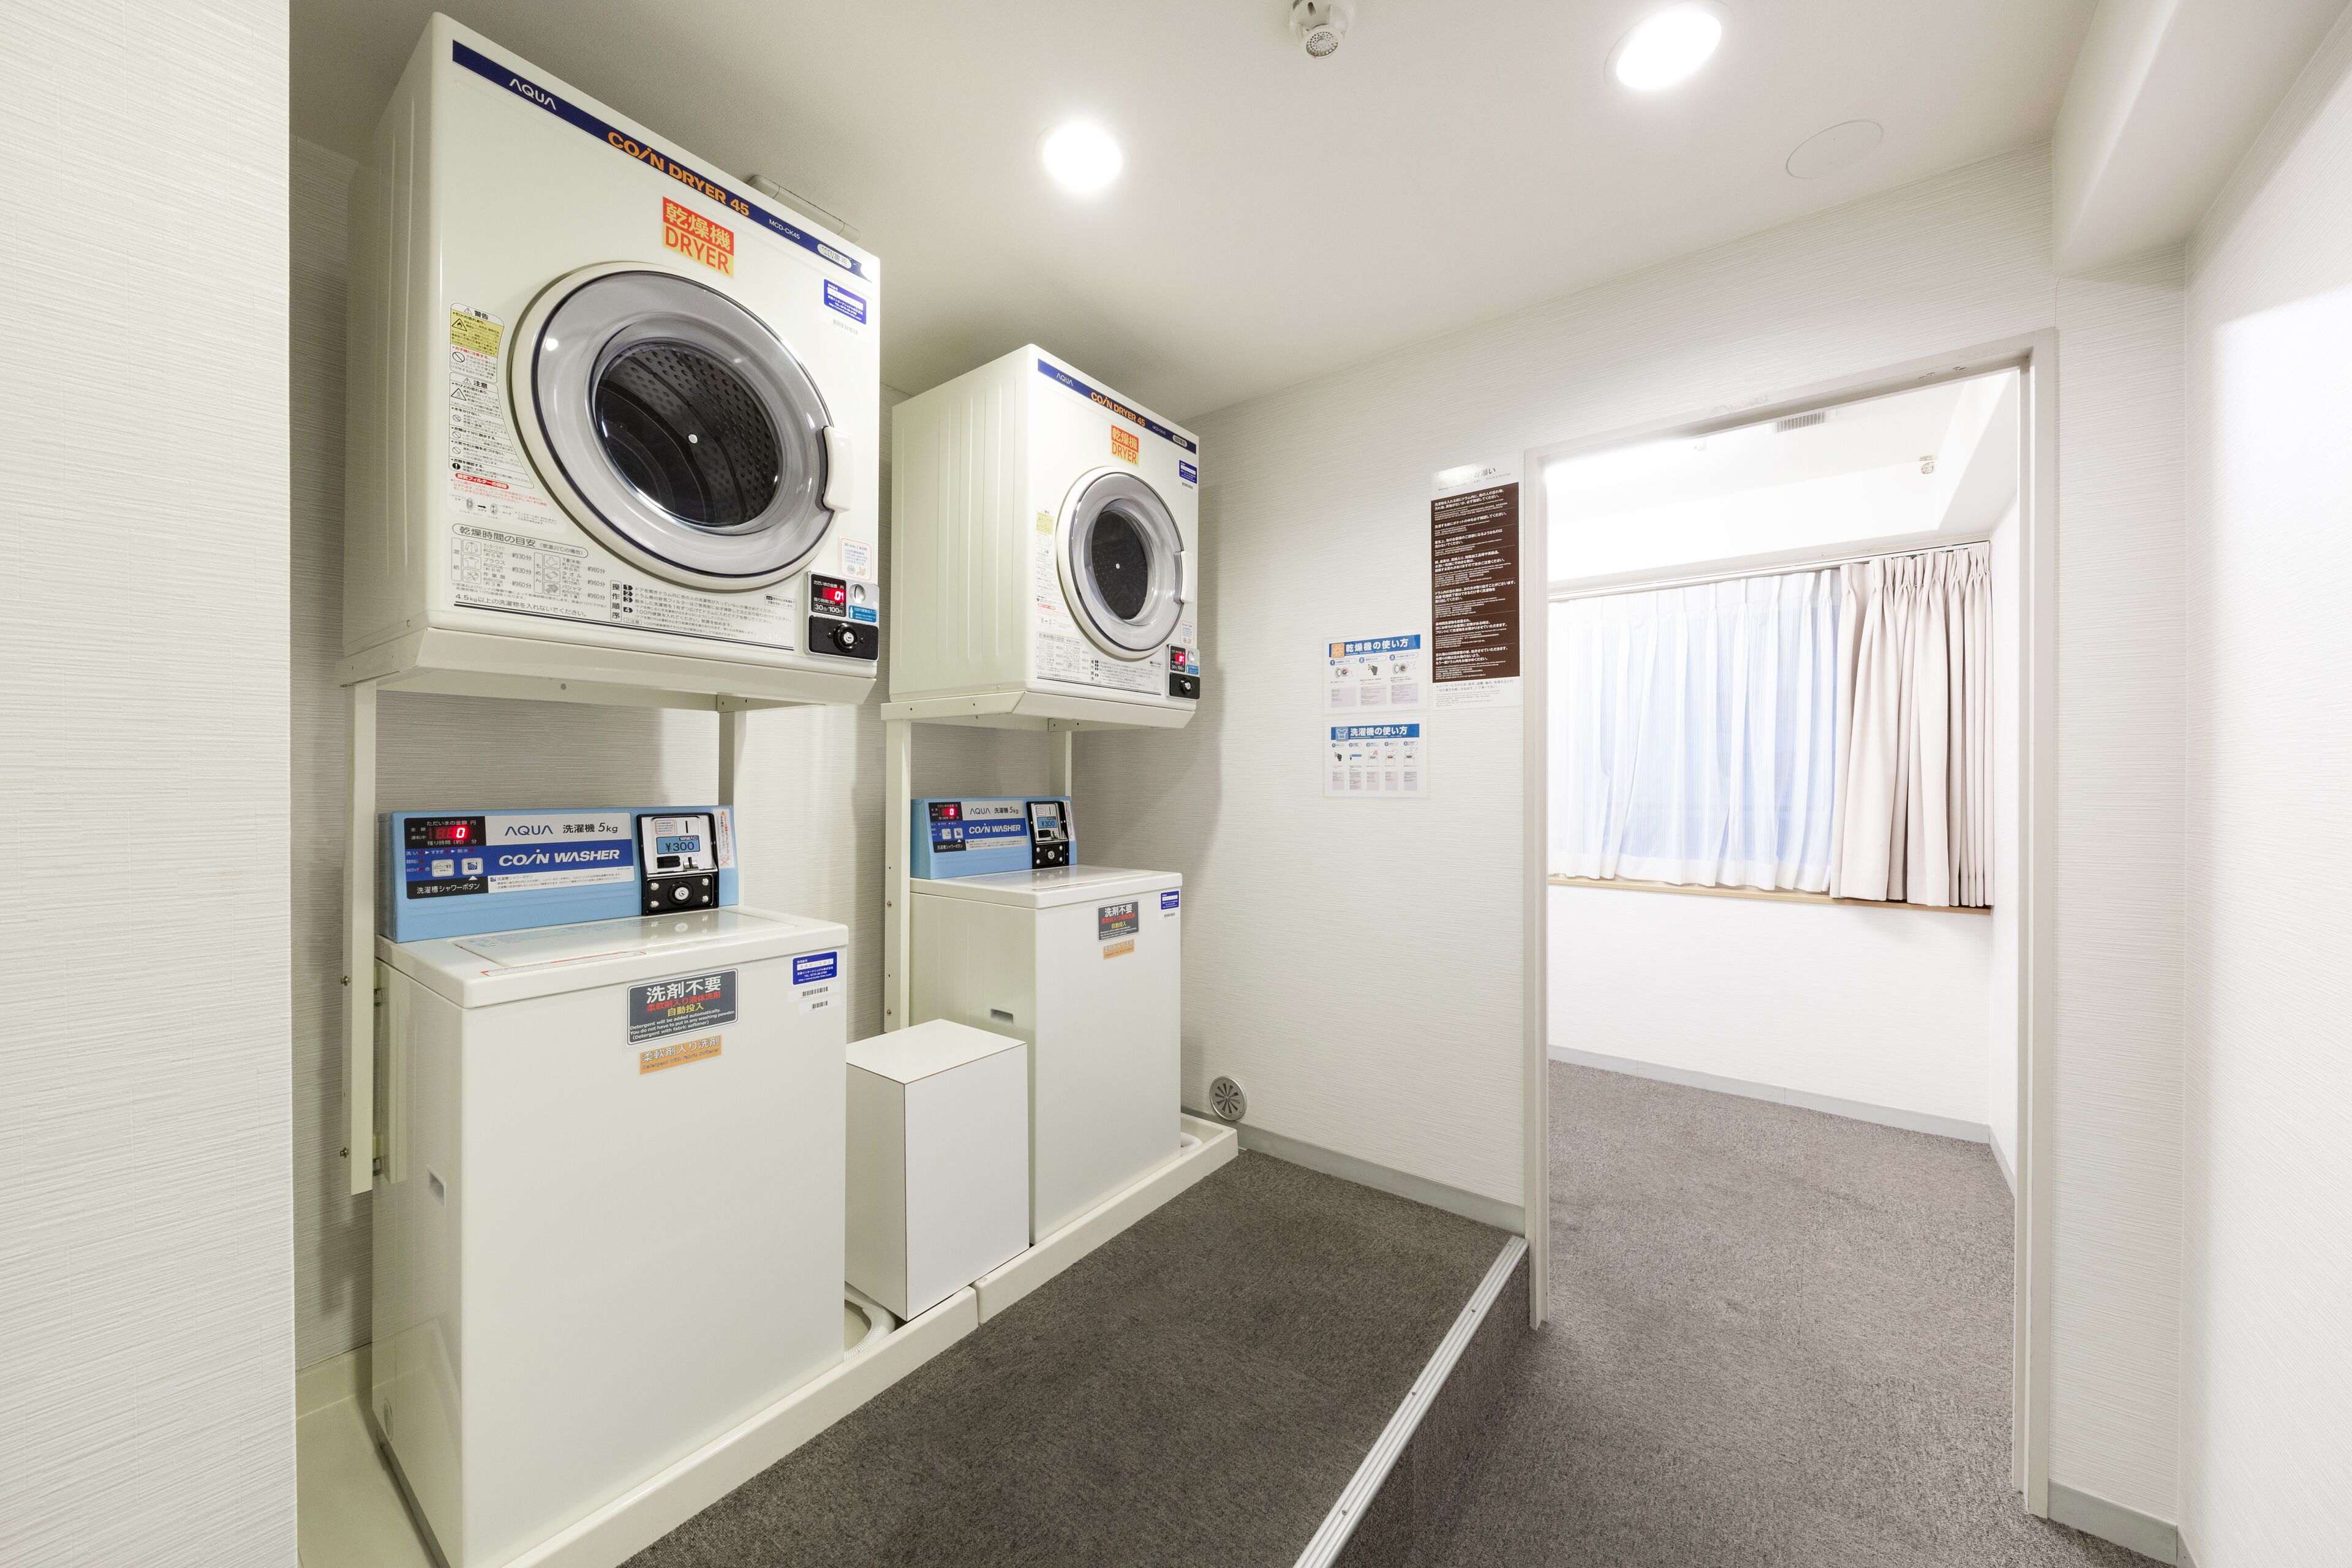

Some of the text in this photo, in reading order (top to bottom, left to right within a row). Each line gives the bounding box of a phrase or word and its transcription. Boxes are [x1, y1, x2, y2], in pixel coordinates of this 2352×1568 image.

[509, 78, 556, 111] AQUA
[668, 162, 726, 205] DRYER
[730, 198, 749, 217] 45
[665, 202, 731, 252] 乾燥機
[768, 218, 801, 240] MCD-CK45
[665, 226, 730, 275] DRYER
[473, 380, 488, 389] 注意
[1056, 372, 1073, 386] AQUA
[1114, 403, 1137, 423] DRYER
[1137, 418, 1145, 428] 45
[1112, 427, 1137, 450] 乾燥機
[1112, 442, 1137, 466] DRYER
[459, 526, 537, 548] 乾燥時間の目安
[512, 552, 532, 562] 約30分
[512, 567, 532, 576] 約30分
[587, 565, 605, 575] 約60分
[512, 581, 532, 589] 約60分
[587, 579, 605, 587] 約60分
[813, 580, 838, 589] ただいまの金額
[587, 592, 605, 601] 約60分
[612, 583, 620, 620] 操作順序
[455, 594, 587, 617] 4.5kg以上の洗濯物を入れないでください。
[1346, 638, 1409, 654] 乾燥機の使い方
[1350, 726, 1408, 737] 洗濯機の使い方
[504, 822, 618, 836] AQUA 洗濯機 5kg
[992, 824, 1021, 833] WASHER
[665, 842, 695, 852] ¥300
[554, 849, 620, 864] WASHER
[417, 883, 480, 895] 洗濯槽シャワーボタン
[1104, 903, 1133, 918] 洗剤不要
[646, 975, 722, 1005] 洗剤不要
[646, 990, 722, 1012] 柔軟剤入り液体洗剤
[667, 1002, 704, 1017] 自動投入
[698, 1013, 717, 1023] washing
[717, 1009, 736, 1018] powder.
[630, 1021, 655, 1031] Detergent
[689, 1008, 721, 1019] automatically.
[632, 1030, 661, 1040] (Detergent
[687, 1019, 709, 1028] softener)
[641, 1035, 720, 1063] 柔軟剤入り洗剤
